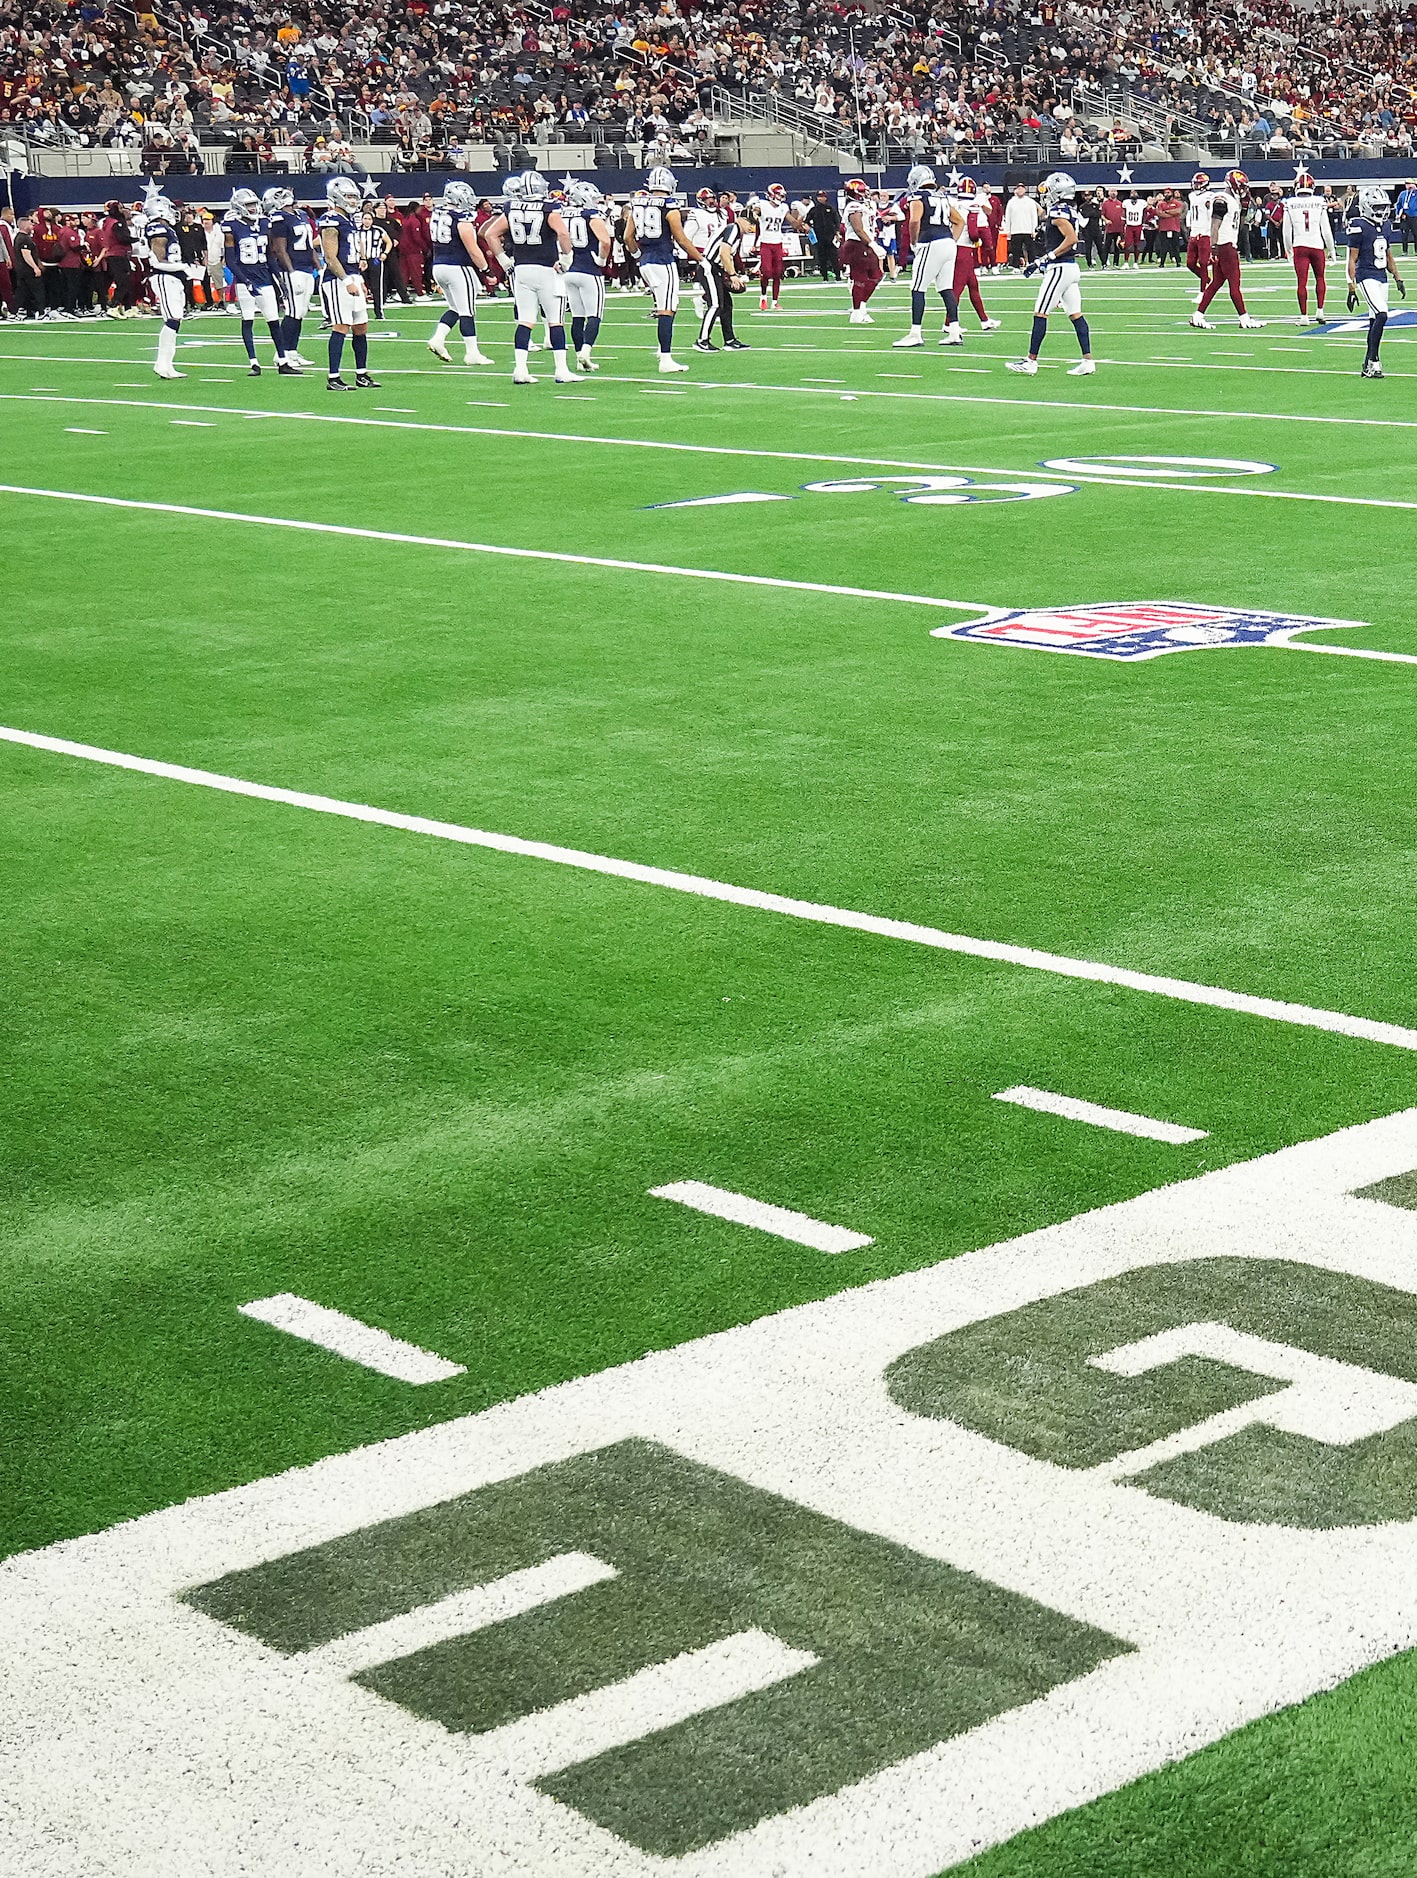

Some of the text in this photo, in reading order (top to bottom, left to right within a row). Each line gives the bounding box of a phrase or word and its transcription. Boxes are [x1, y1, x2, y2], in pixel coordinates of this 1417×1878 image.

[508, 209, 544, 245] 67
[632, 205, 663, 239] 89
[765, 217, 782, 232] 25
[1302, 210, 1310, 232] 1
[1373, 239, 1387, 270] 9
[802, 456, 1279, 505] 30
